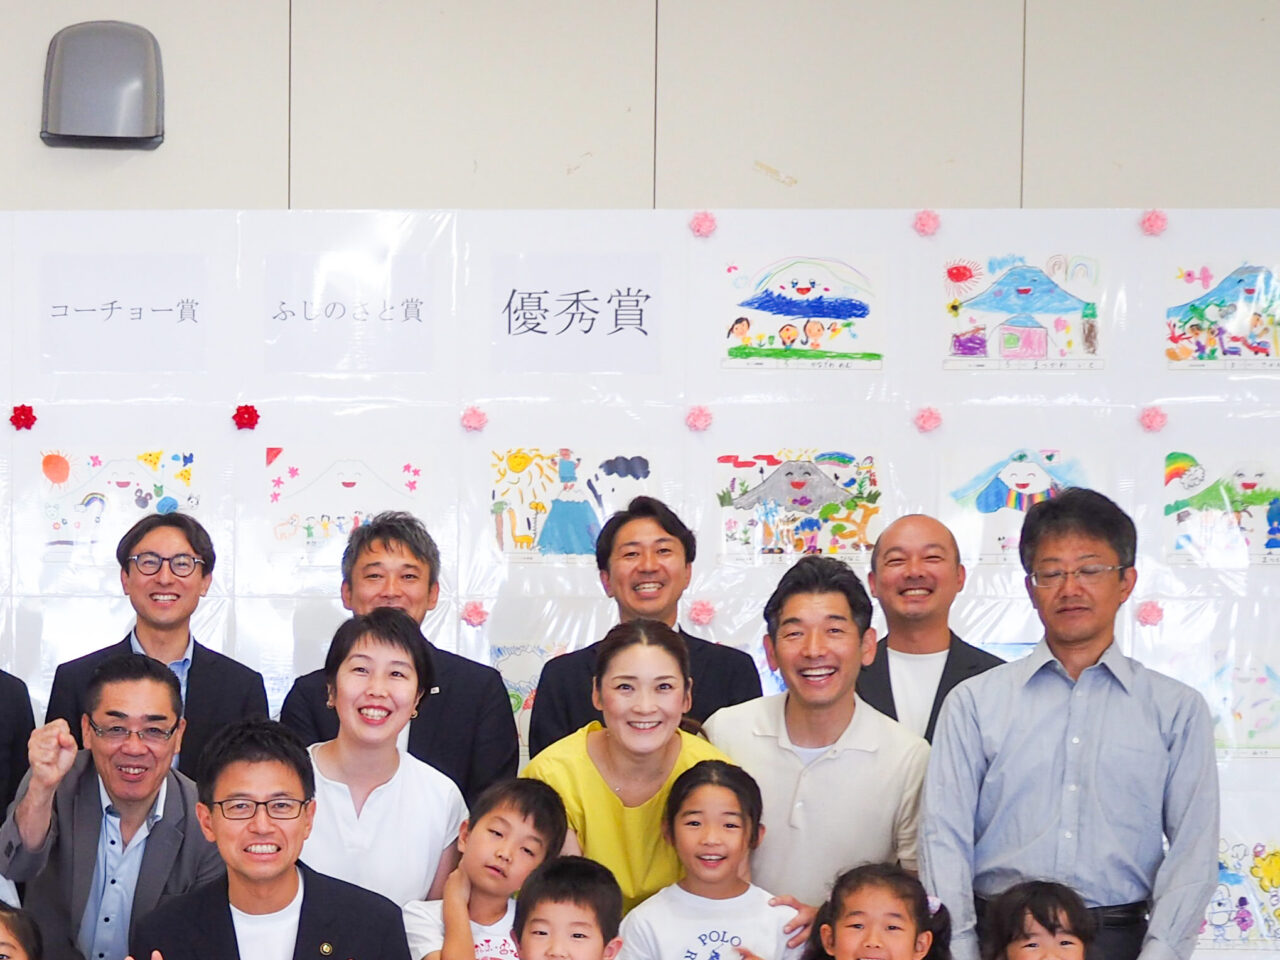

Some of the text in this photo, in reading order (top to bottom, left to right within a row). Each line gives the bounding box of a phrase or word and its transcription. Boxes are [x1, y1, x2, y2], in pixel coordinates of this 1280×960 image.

[50, 297, 200, 324] コーチョー賞
[272, 296, 425, 323] ふじのさと賞
[501, 287, 652, 338] 優秀賞
[697, 930, 742, 947] POLO
